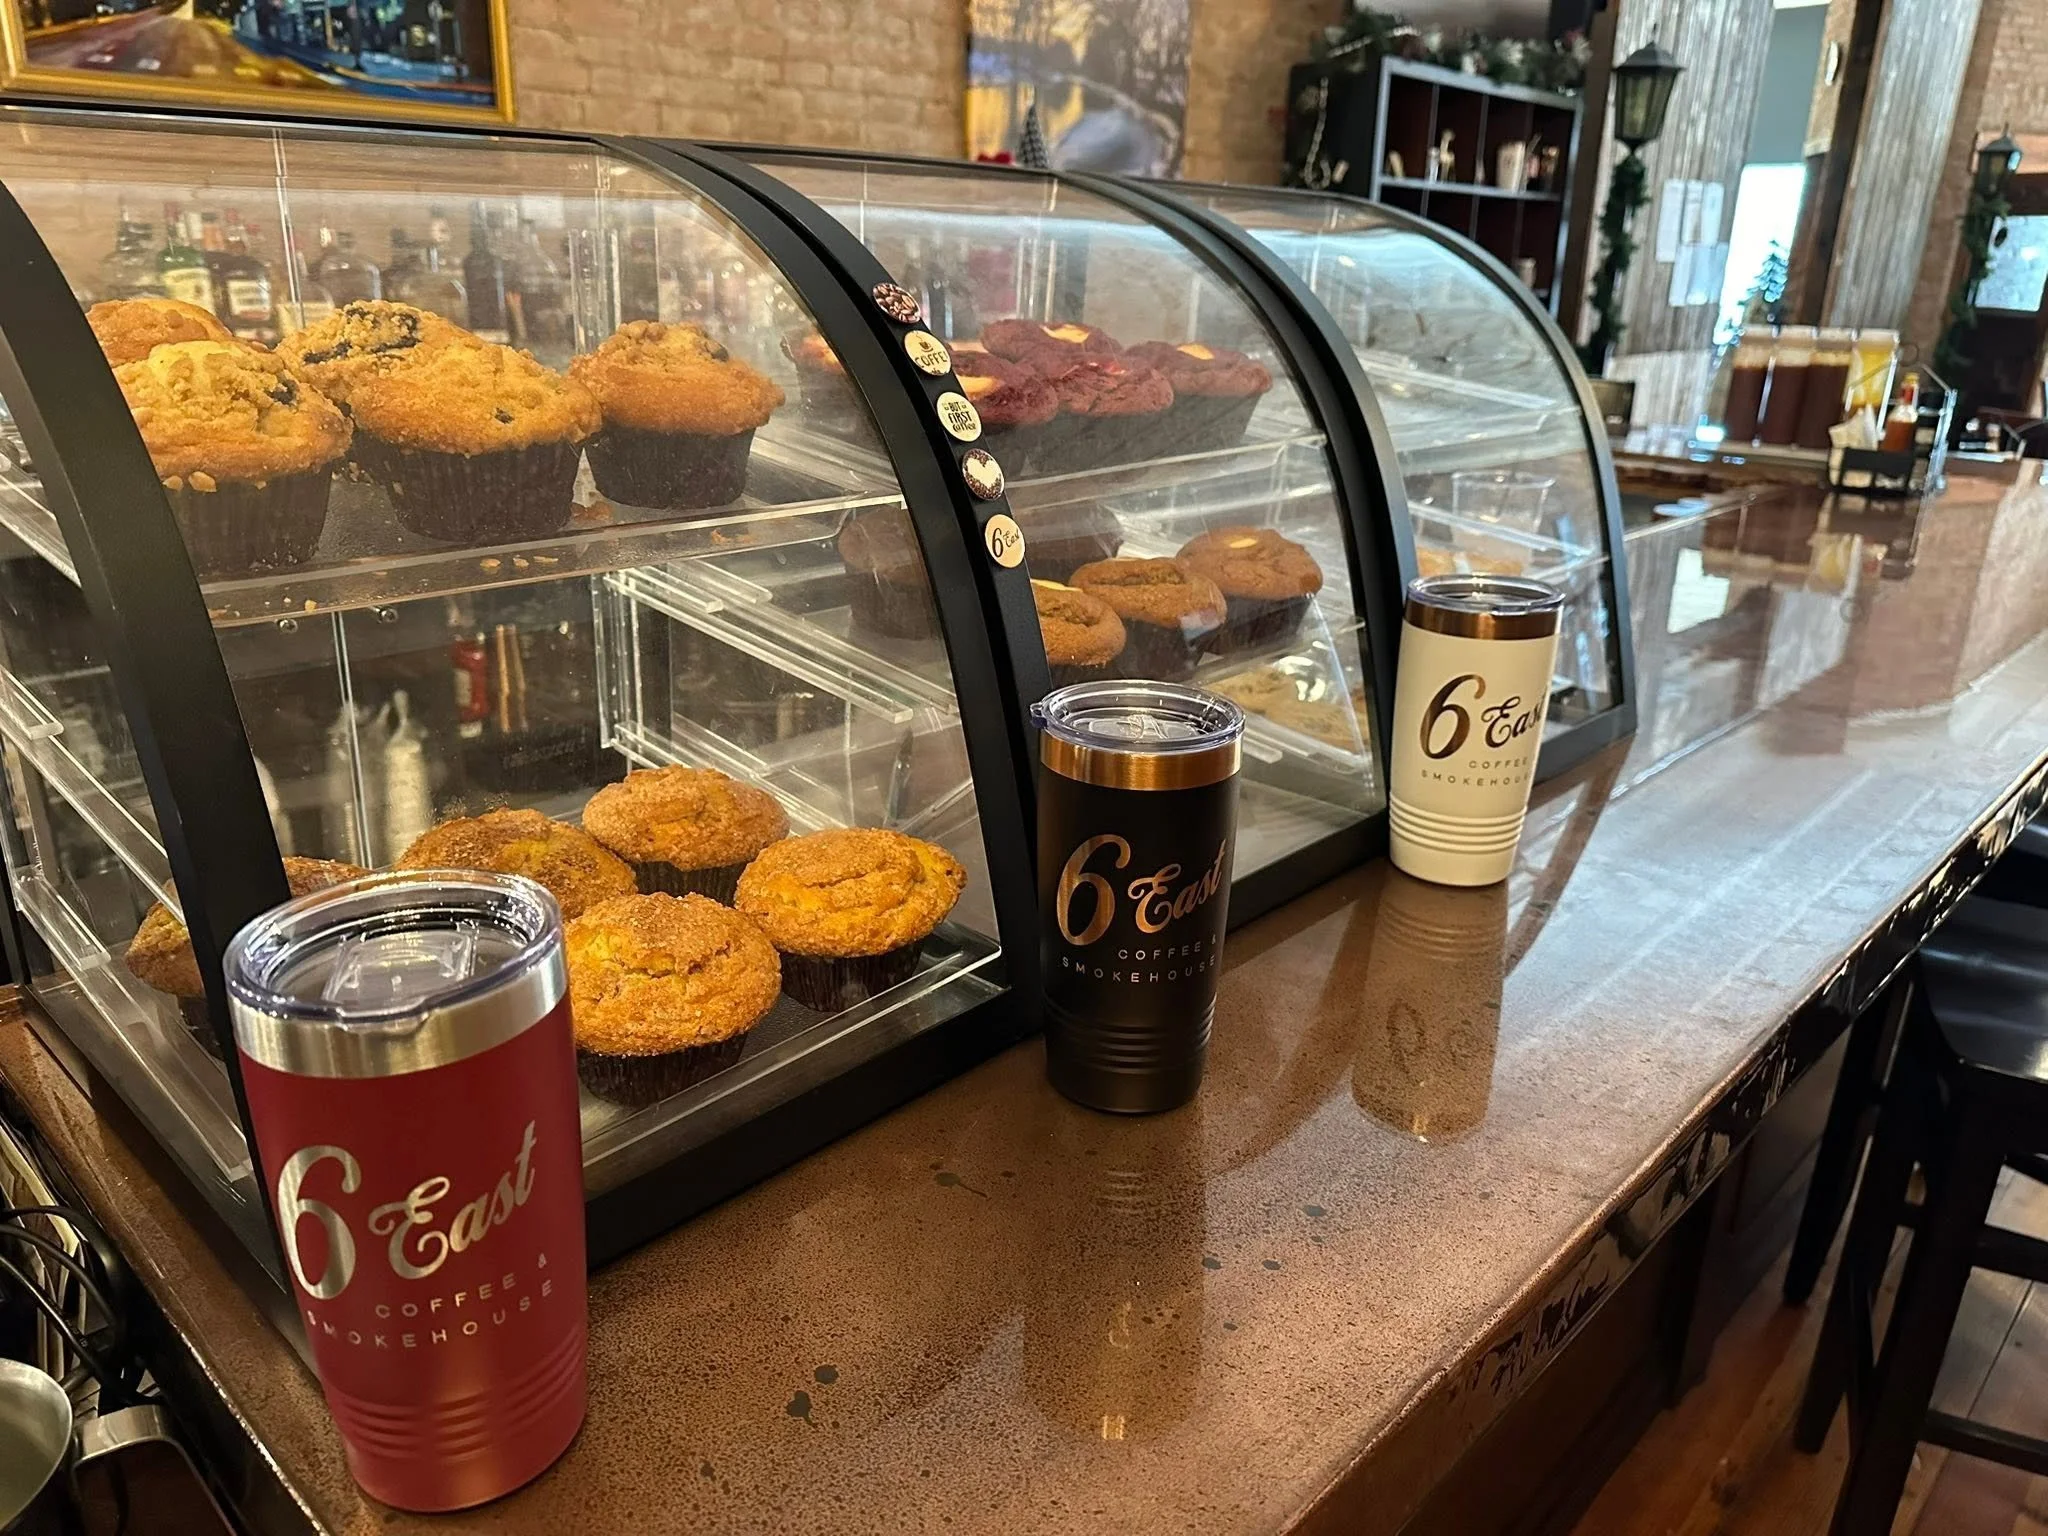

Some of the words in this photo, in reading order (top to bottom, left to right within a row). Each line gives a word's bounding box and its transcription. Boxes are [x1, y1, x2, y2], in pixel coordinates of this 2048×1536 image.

[914, 350, 949, 369] COFFE
[948, 402, 961, 412] BUT
[948, 411, 972, 424] FIRST
[992, 528, 1003, 558] 6
[1419, 674, 1486, 760] 6
[1057, 834, 1131, 946] 6
[1128, 838, 1226, 934] East
[1118, 941, 1201, 961] COFFEE
[1062, 955, 1216, 984] SMOKEHOUSE
[278, 1144, 362, 1301] 6
[368, 1119, 538, 1280] East
[374, 1272, 517, 1319] COFFEE
[537, 1252, 548, 1269] &
